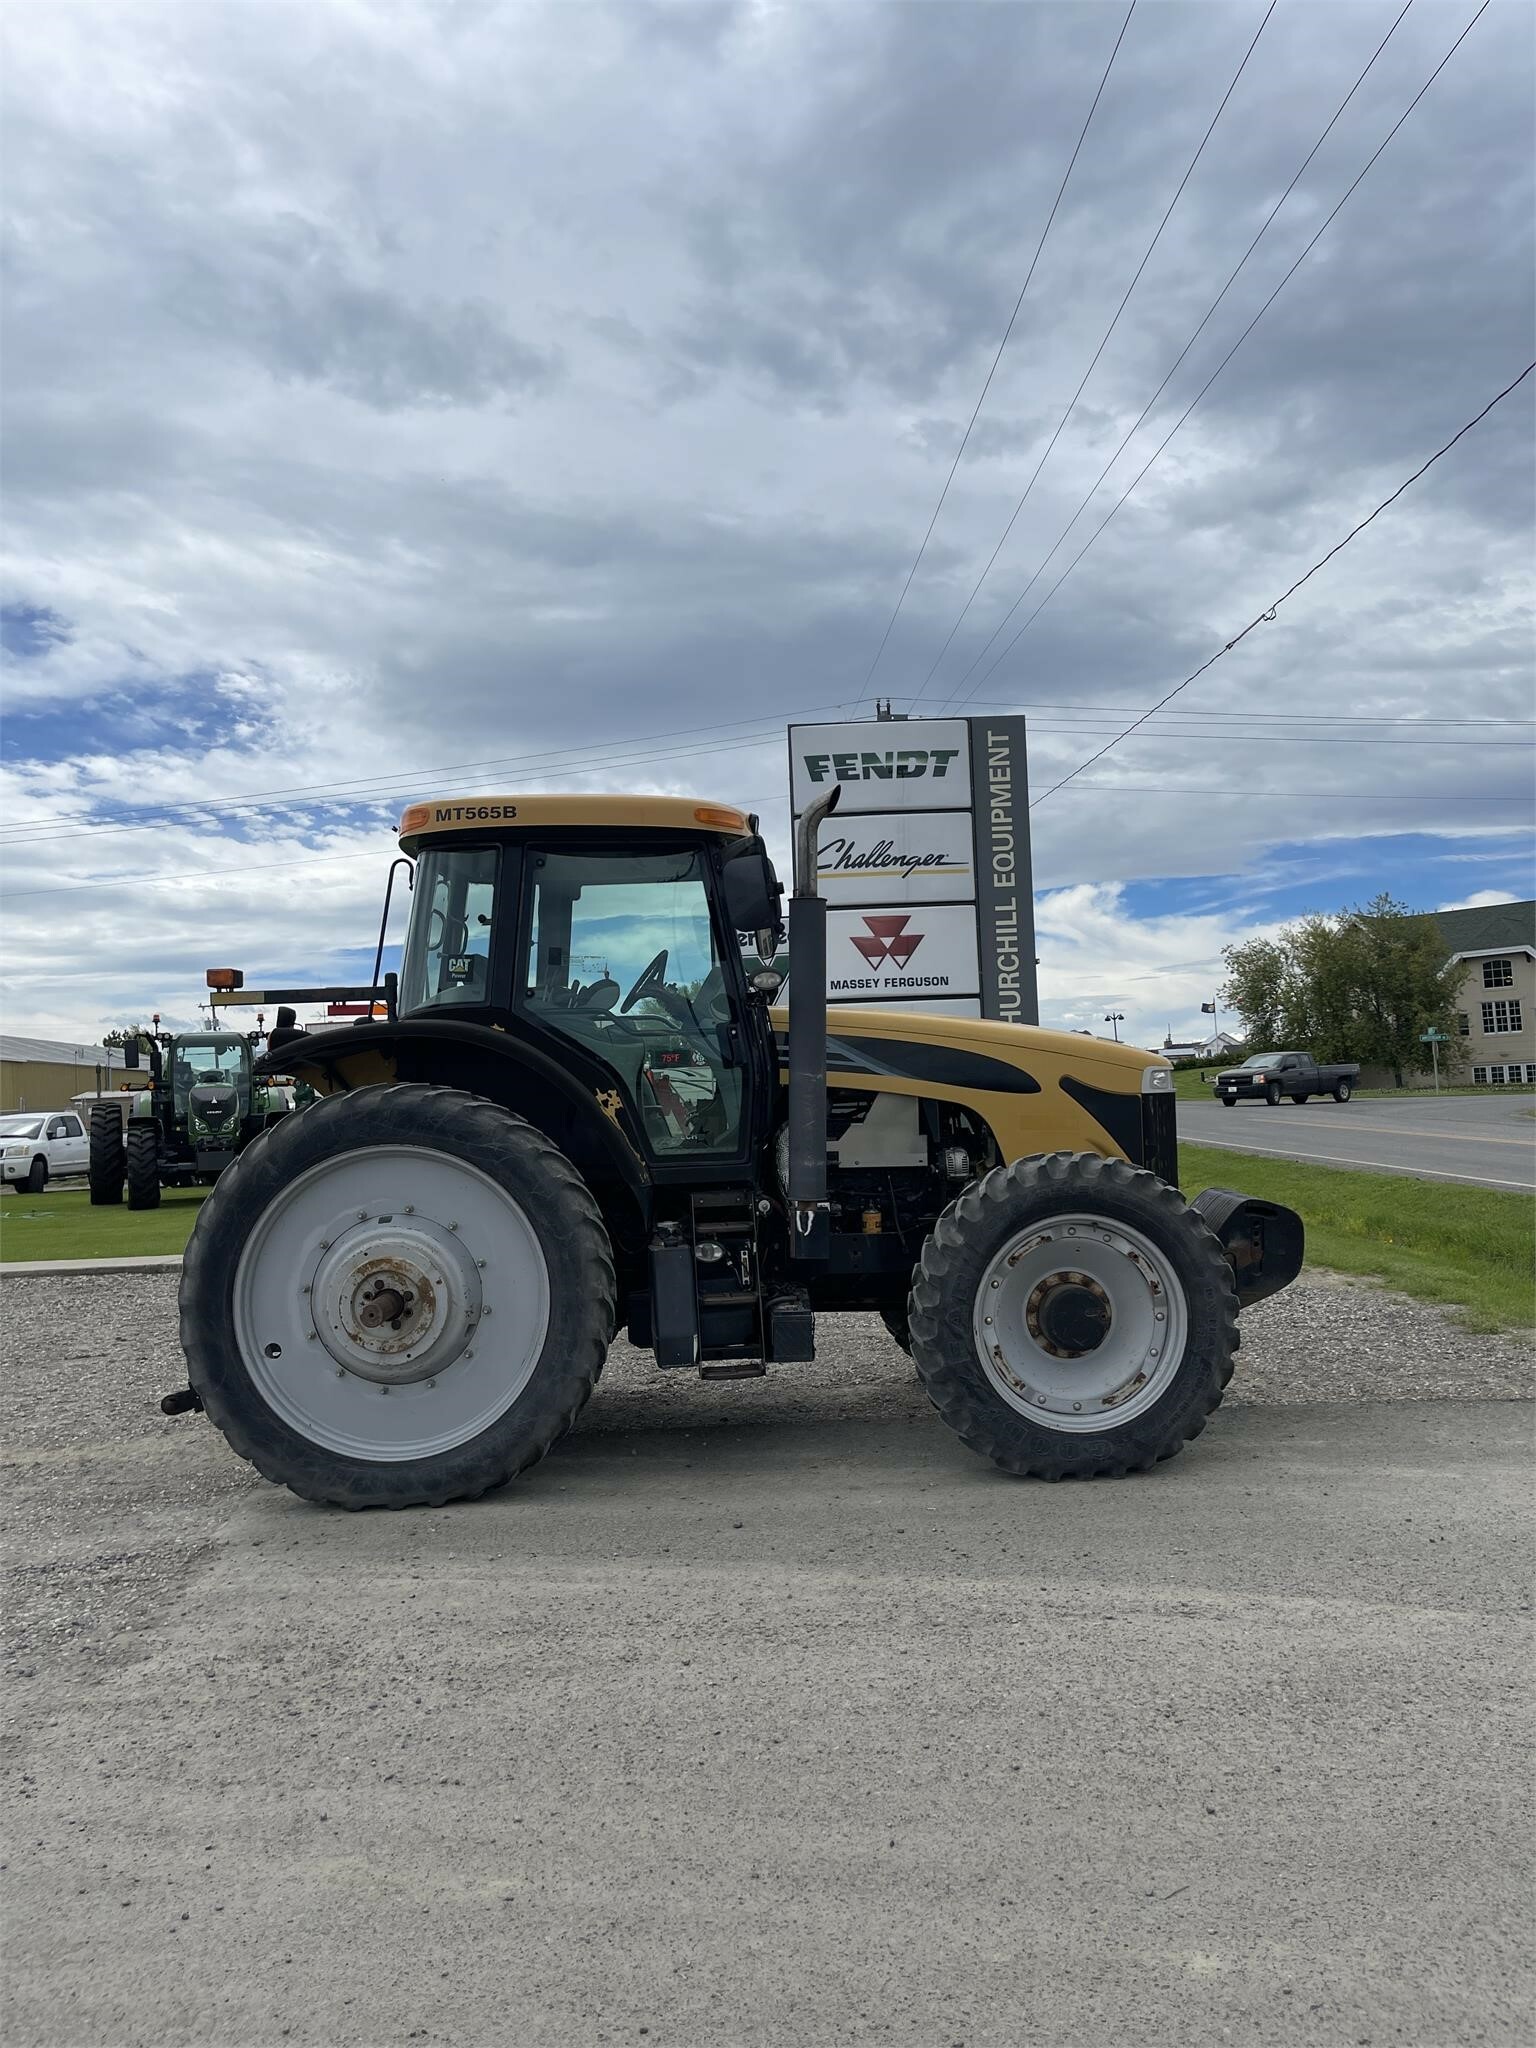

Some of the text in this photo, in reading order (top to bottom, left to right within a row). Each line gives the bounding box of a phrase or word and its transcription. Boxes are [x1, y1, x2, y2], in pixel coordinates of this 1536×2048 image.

[803, 749, 960, 783] FENDT
[435, 805, 518, 823] MT565B
[817, 838, 969, 879] Challenger
[987, 730, 1022, 1023] HURCHILL EQUIPMENT
[448, 958, 472, 972] CAT
[830, 976, 949, 990] MASSEY FERGUSON
